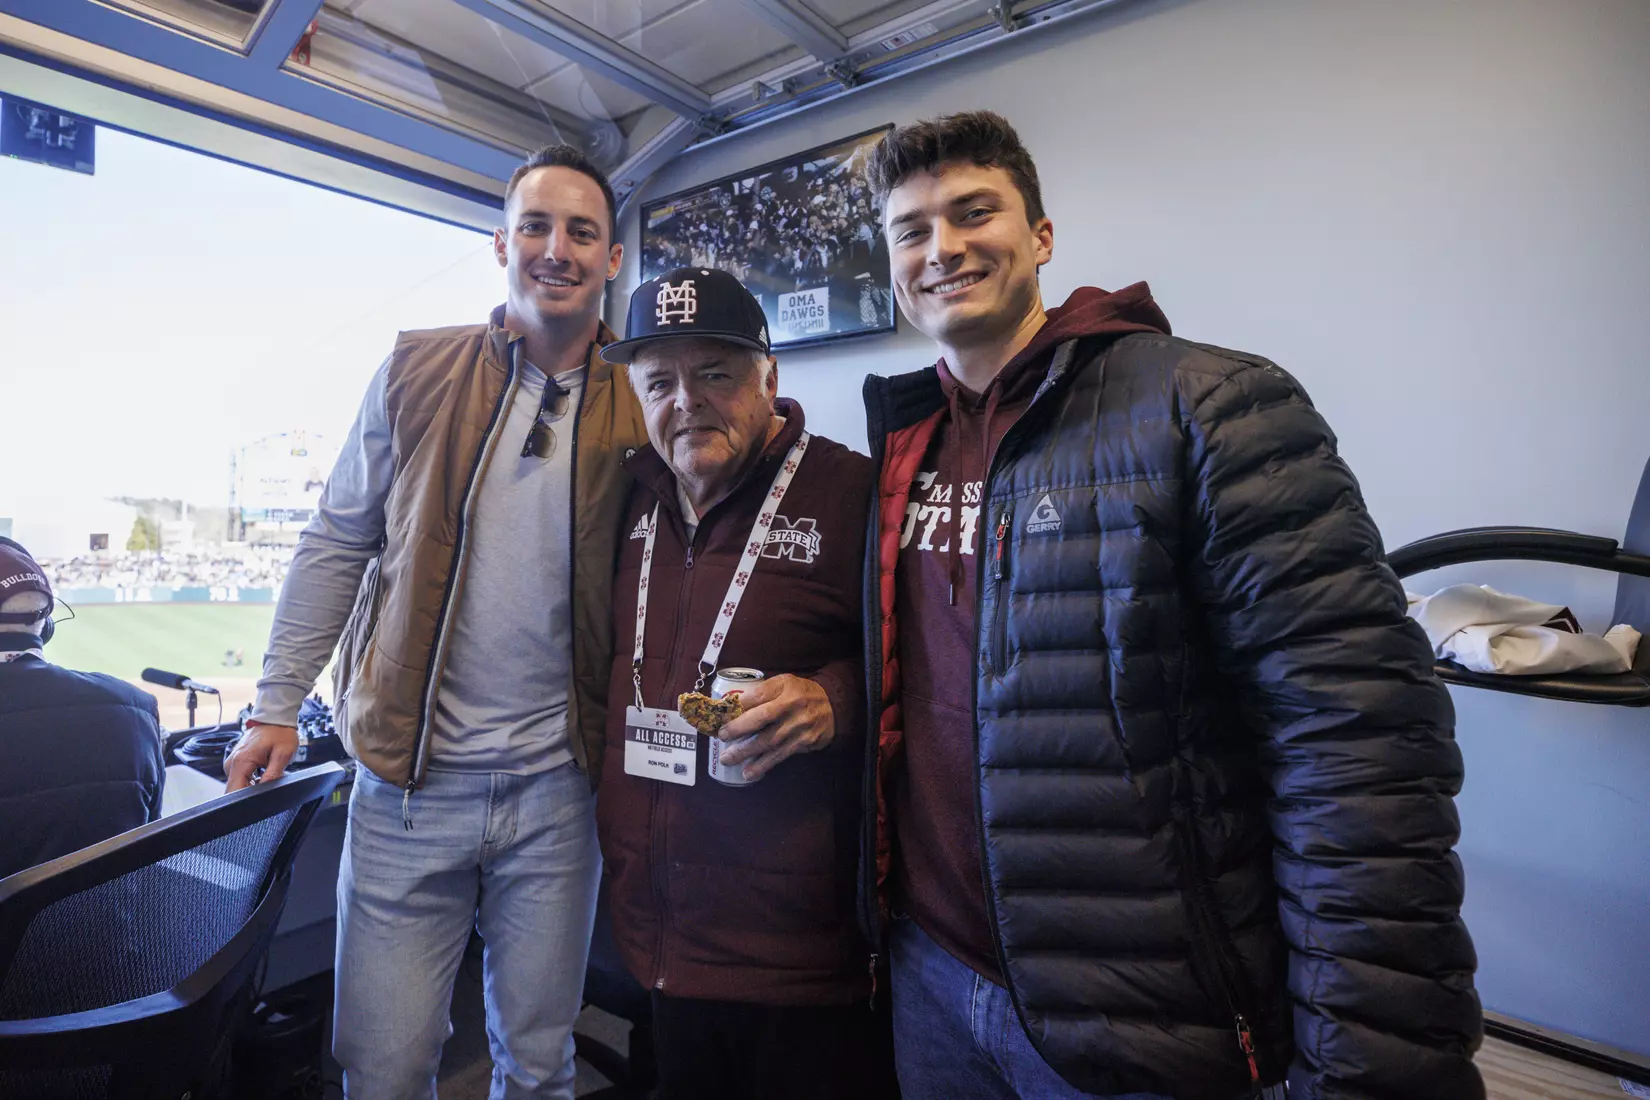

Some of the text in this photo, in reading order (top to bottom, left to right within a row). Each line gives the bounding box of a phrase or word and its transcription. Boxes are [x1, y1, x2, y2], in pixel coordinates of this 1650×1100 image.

[789, 293, 816, 307] OMA
[782, 305, 825, 322] DAWGS
[926, 481, 982, 503] MSS
[1026, 522, 1062, 534] GERRY
[768, 531, 808, 547] STATE
[635, 729, 650, 741] ALL
[652, 731, 687, 748] ACCESS
